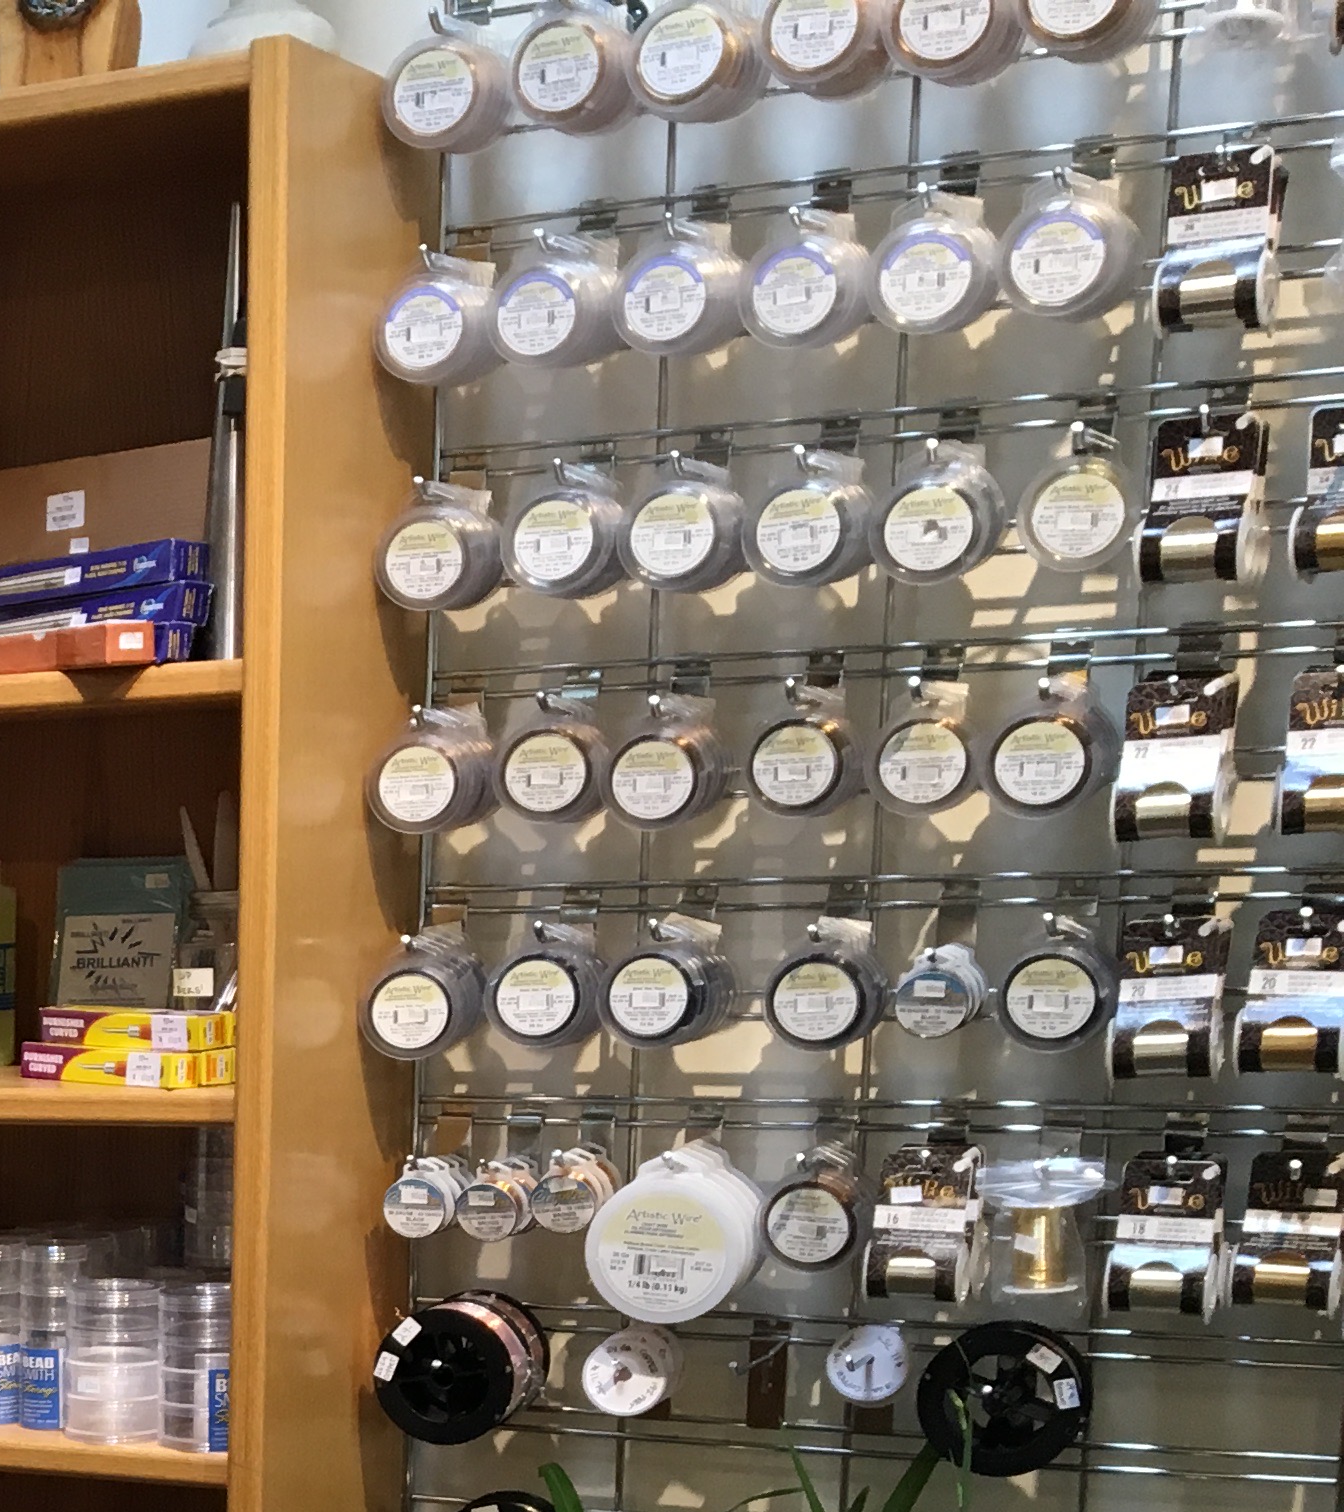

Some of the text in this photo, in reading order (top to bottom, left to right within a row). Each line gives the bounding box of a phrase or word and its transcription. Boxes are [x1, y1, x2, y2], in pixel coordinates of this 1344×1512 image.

[1261, 977, 1277, 989] 20
[625, 1208, 702, 1226] Artistic Wire
[886, 1213, 900, 1224] 16
[1132, 1221, 1146, 1235] 18
[627, 1279, 640, 1289] 1/4
[641, 1280, 651, 1289] lb
[673, 1284, 688, 1295] kg)
[22, 1355, 55, 1369] BEAD
